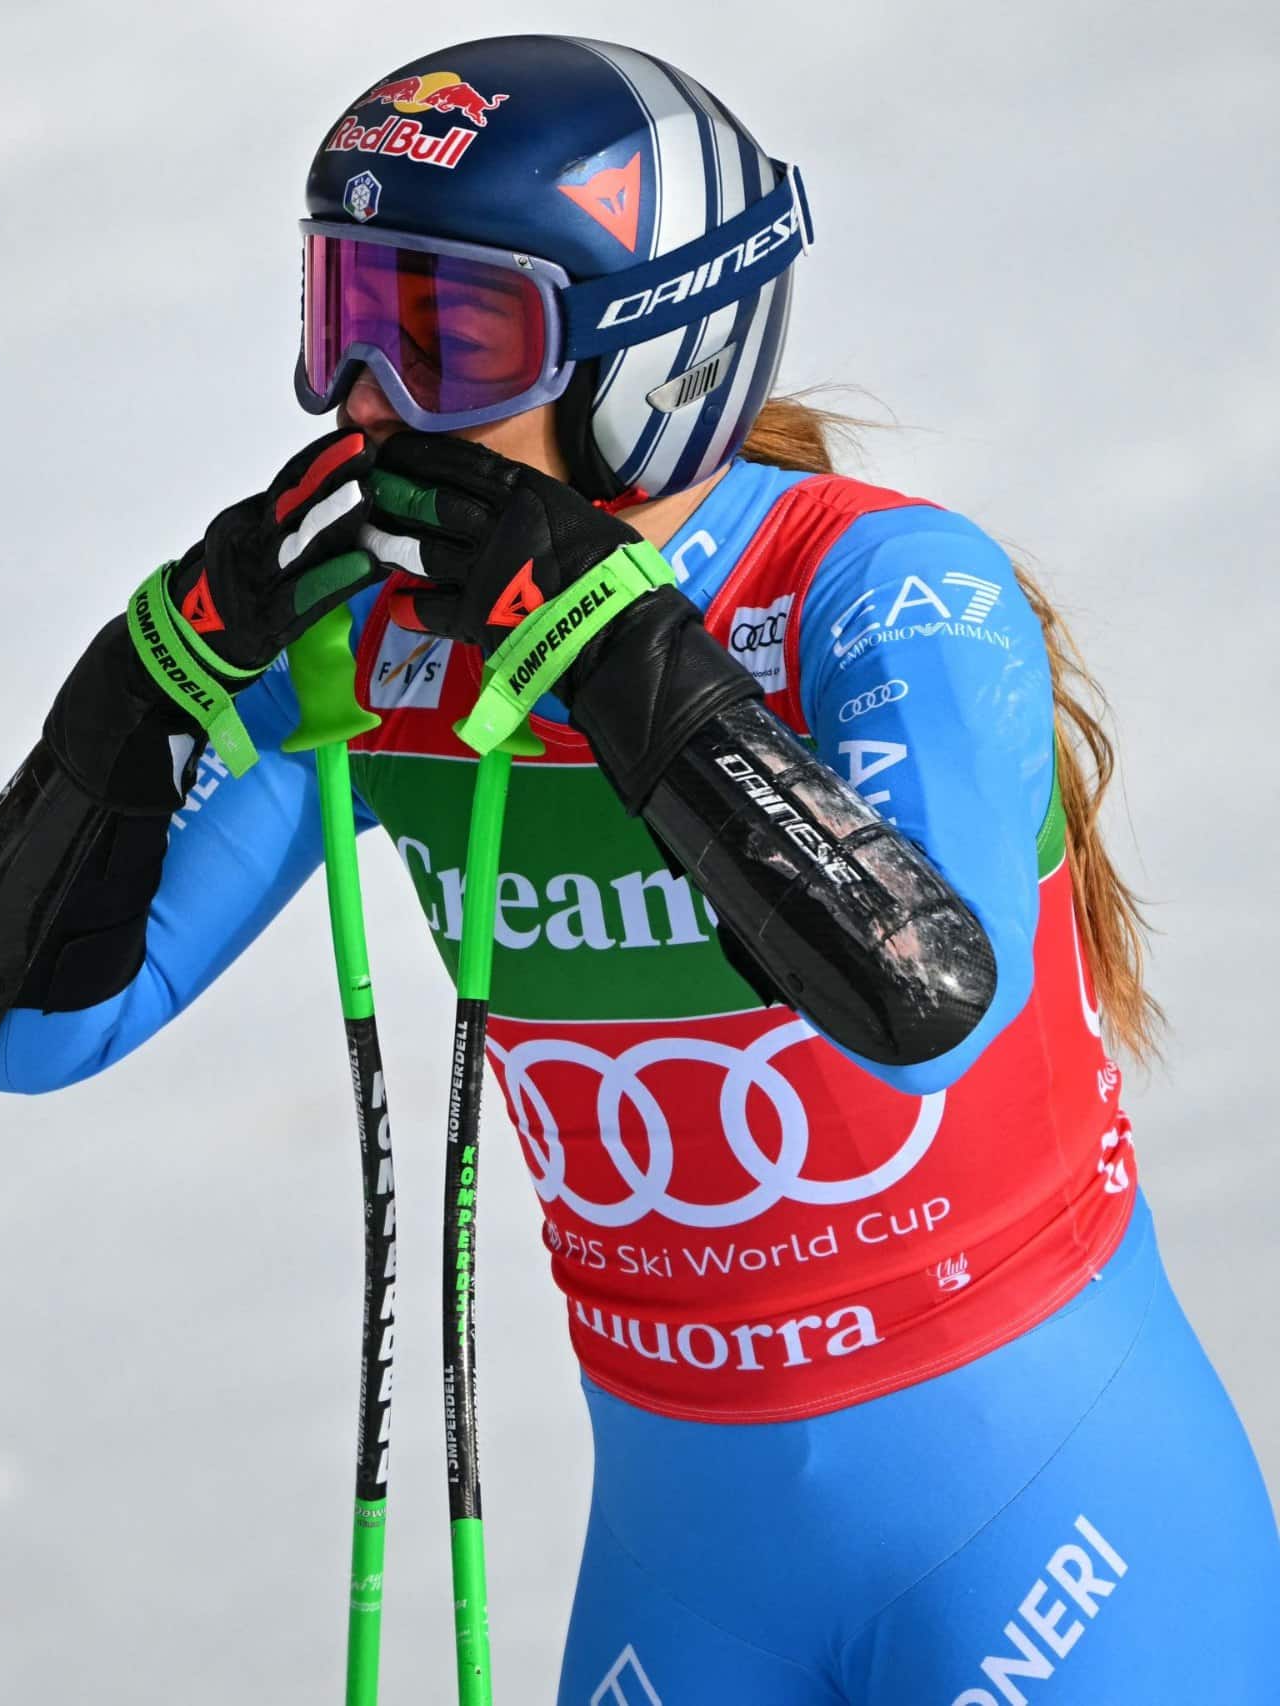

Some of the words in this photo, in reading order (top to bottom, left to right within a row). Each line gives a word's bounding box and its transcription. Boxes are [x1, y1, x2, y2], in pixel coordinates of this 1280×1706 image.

[326, 116, 400, 154] Red
[380, 118, 478, 170] Bull
[135, 590, 216, 713] KOMPERDELL
[508, 580, 617, 697] KOMPERDELL
[830, 571, 1003, 658] EA7
[935, 622, 1011, 649] ARMANI
[714, 753, 862, 885] DAINESE
[396, 835, 719, 951] Crean
[447, 1020, 468, 1144] KOMPERDELL
[565, 1231, 607, 1270] FIS
[617, 1245, 673, 1278] Ski
[681, 1225, 839, 1277] World
[855, 1196, 951, 1244] Cup
